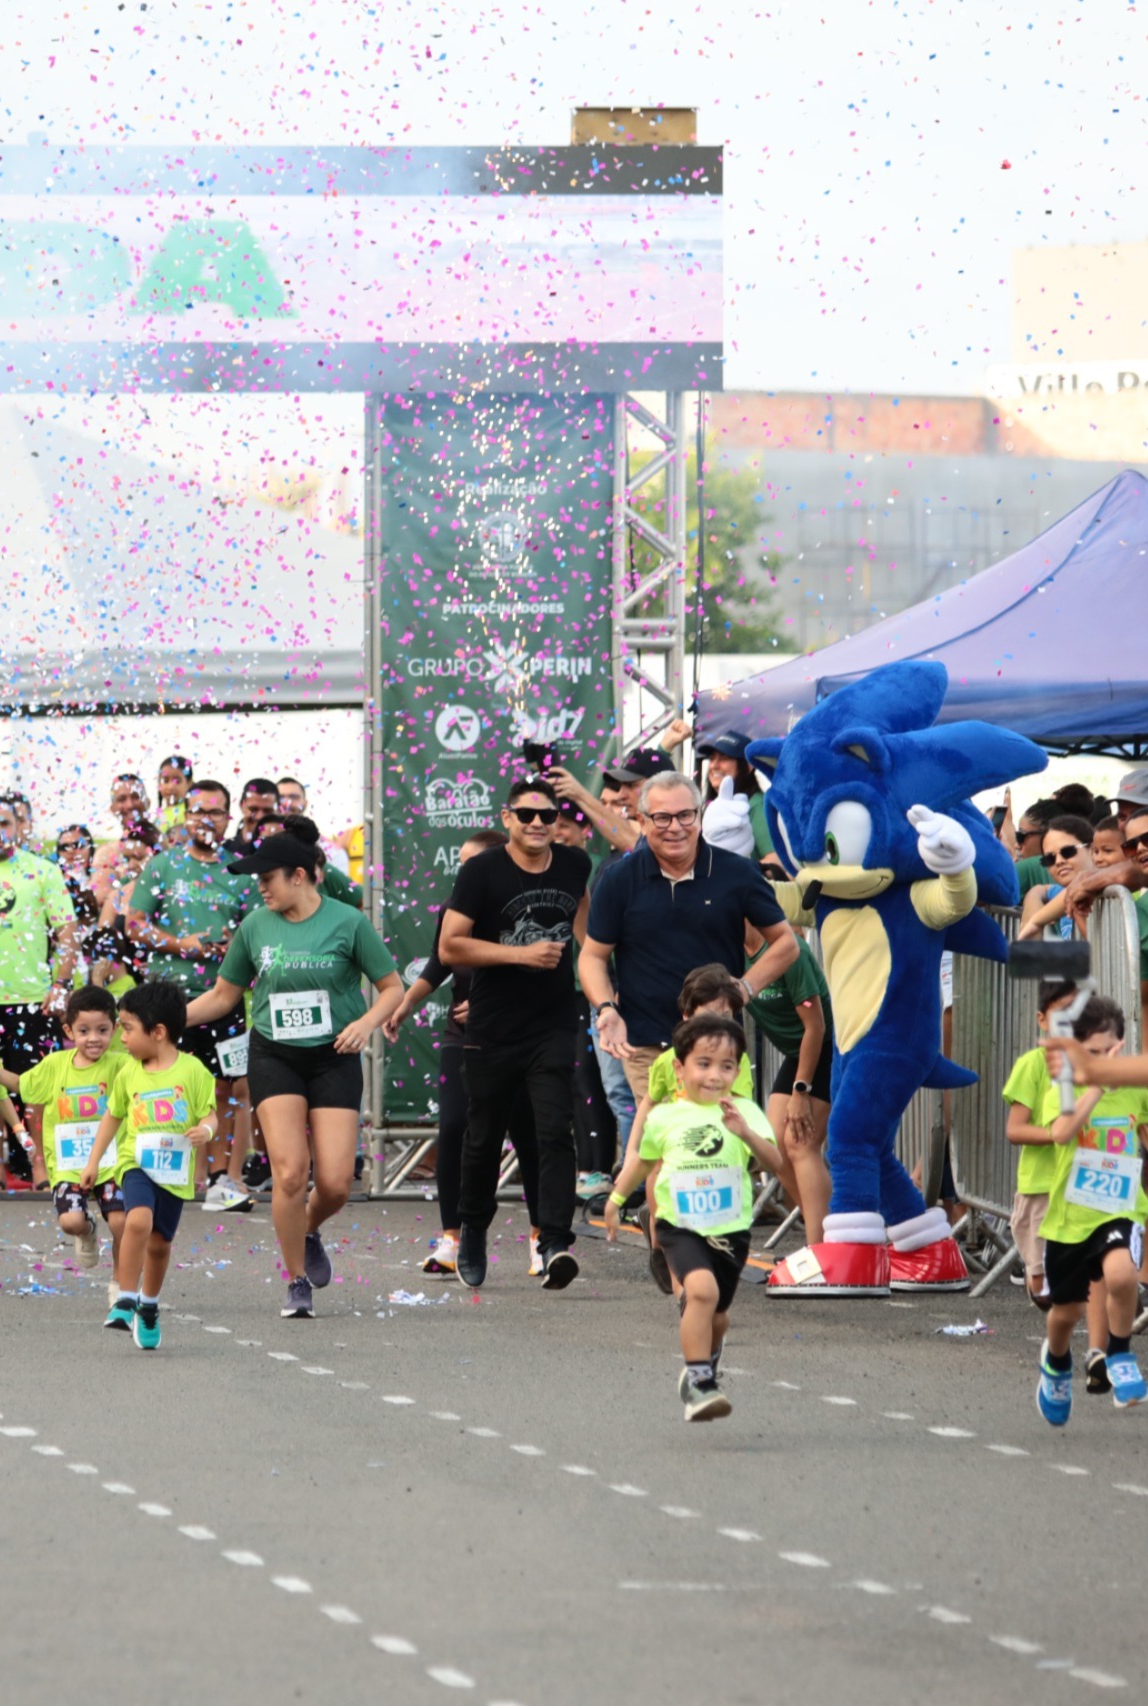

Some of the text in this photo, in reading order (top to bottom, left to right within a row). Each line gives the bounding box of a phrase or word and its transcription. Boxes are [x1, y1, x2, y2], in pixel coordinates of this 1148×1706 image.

[442, 602, 565, 615] PATROCINADORES
[408, 656, 593, 677] GRUPO PERIN
[425, 791, 490, 811] Baratão
[429, 814, 447, 828] dos
[281, 1008, 313, 1027] 598
[132, 1099, 188, 1128] KIDS
[152, 1149, 172, 1170] 112
[1081, 1170, 1122, 1197] 220
[685, 1190, 721, 1213] 100
